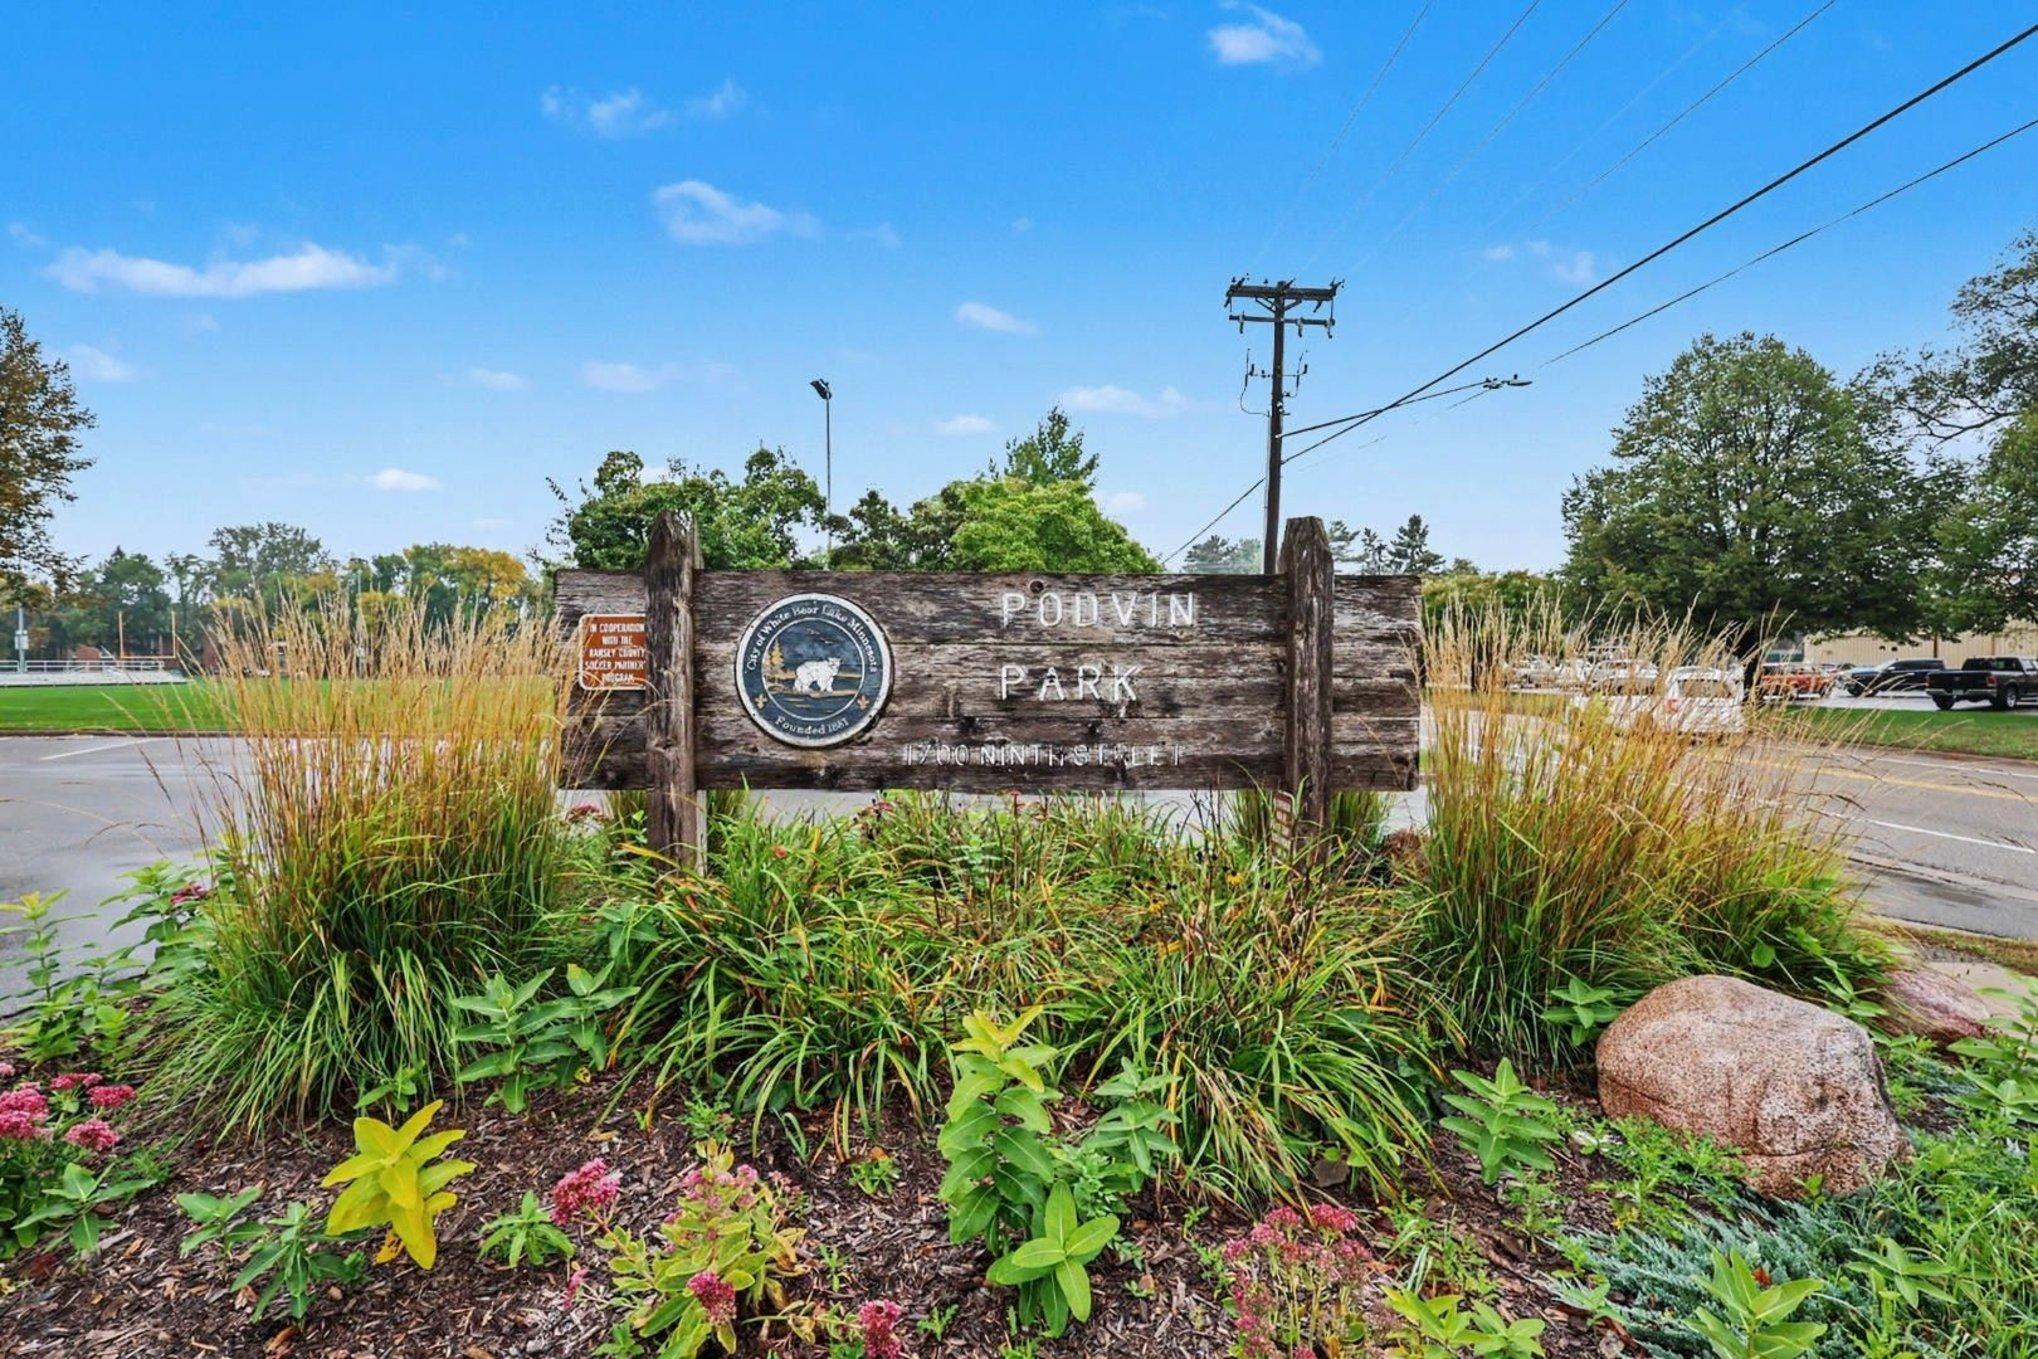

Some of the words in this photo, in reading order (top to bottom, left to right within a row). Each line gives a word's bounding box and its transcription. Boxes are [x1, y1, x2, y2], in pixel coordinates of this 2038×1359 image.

[791, 606, 819, 618] Bear
[821, 604, 848, 622] Lake
[1001, 592, 1195, 627] PODVIN
[760, 612, 790, 635] White
[756, 632, 766, 647] of
[848, 617, 880, 673] Minnesota
[746, 647, 761, 671] City
[1001, 664, 1141, 701] PARK
[775, 716, 826, 734] Founded
[980, 743, 1064, 767] NINTH
